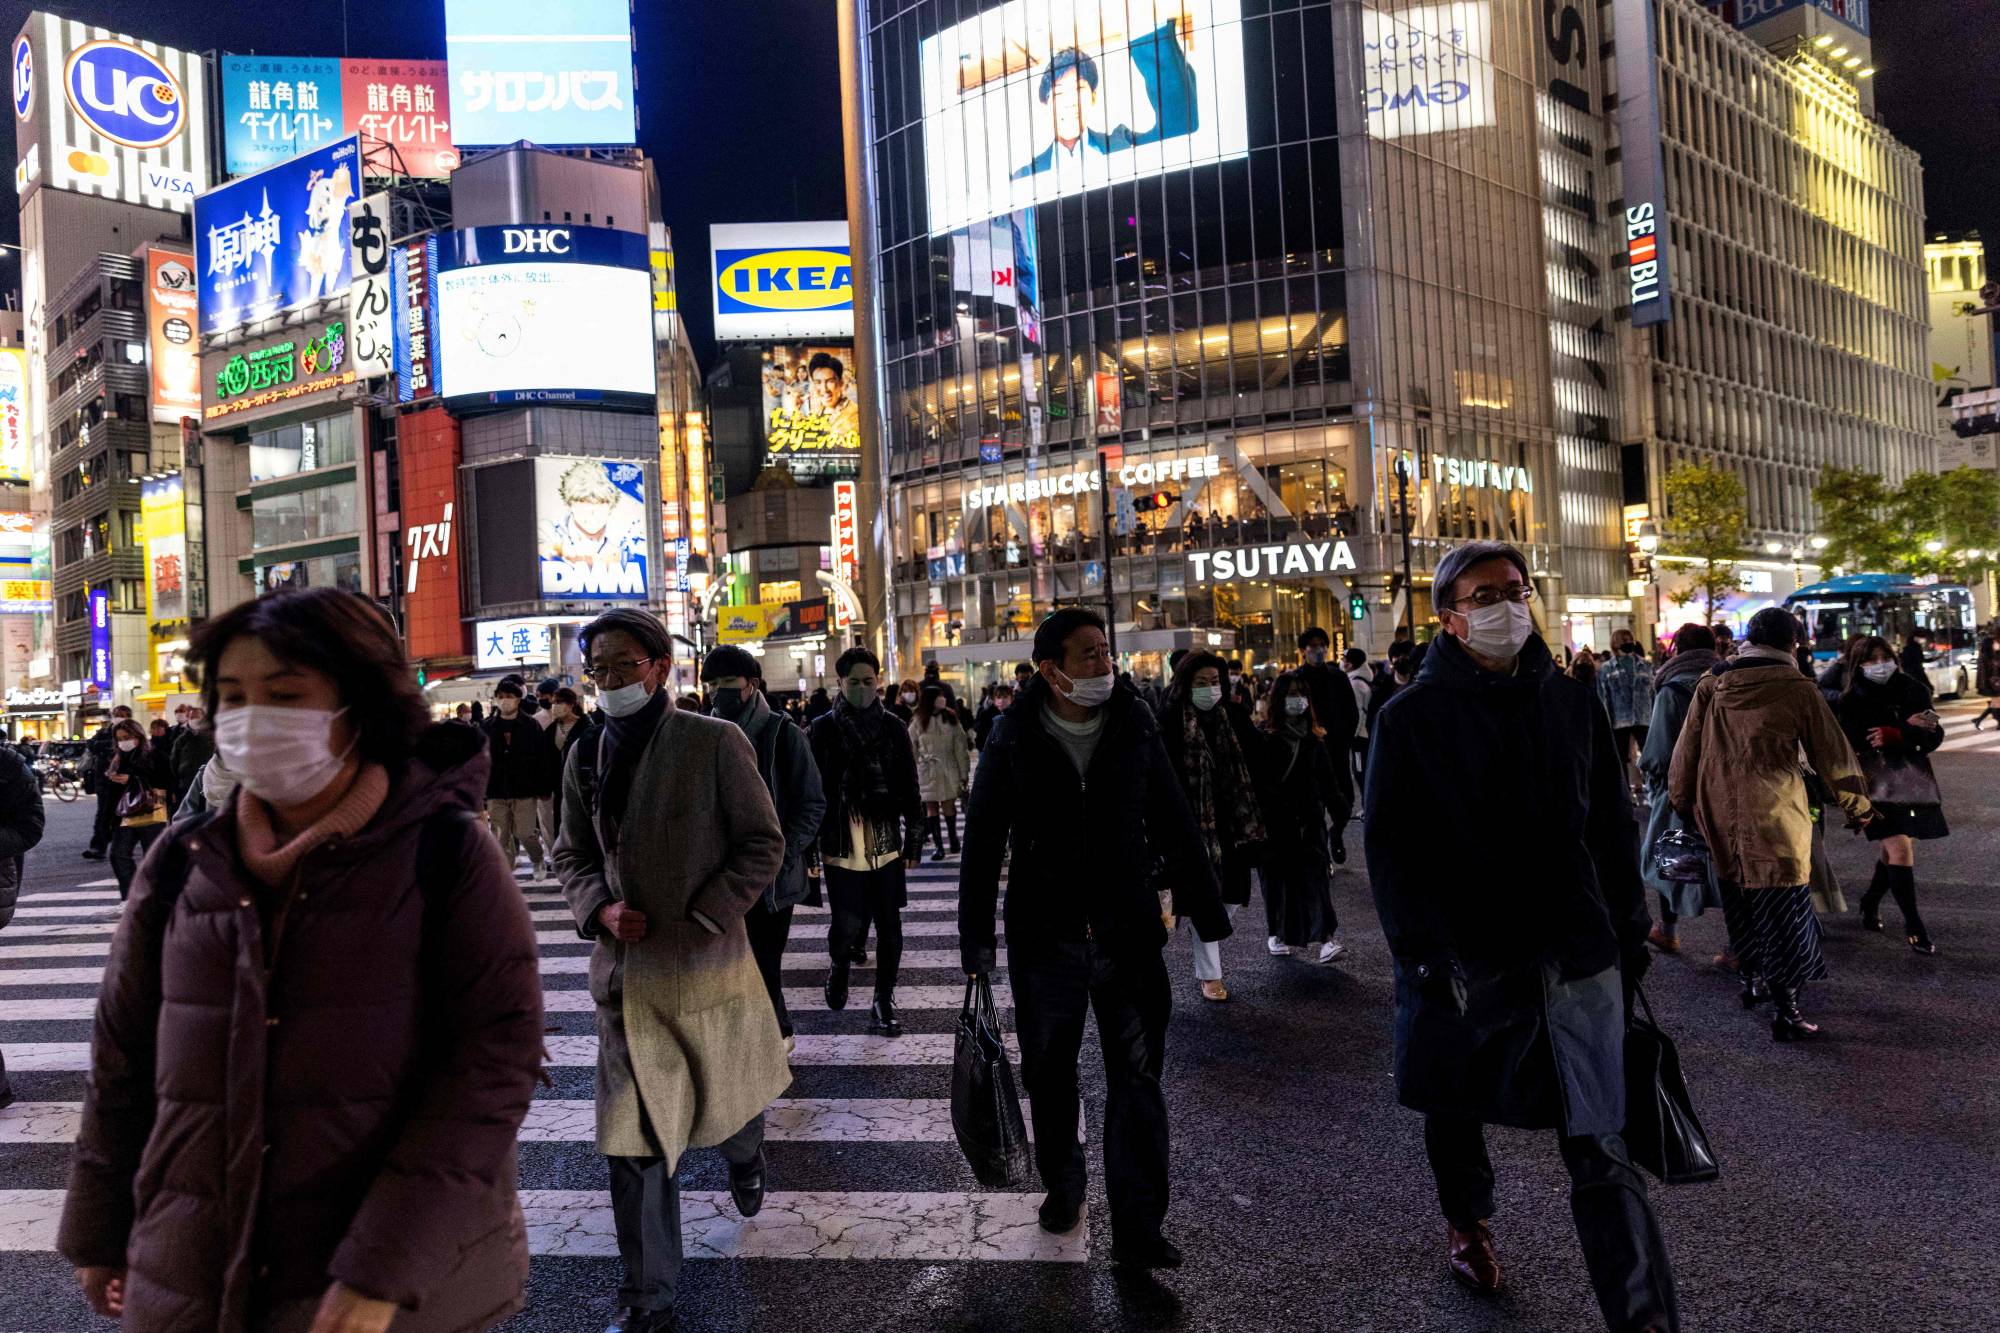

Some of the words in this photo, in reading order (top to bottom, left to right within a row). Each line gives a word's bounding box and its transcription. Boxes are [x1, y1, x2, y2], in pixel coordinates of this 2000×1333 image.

[79, 60, 175, 127] UC
[248, 80, 320, 110] 龍角散
[367, 83, 436, 113] 龍角散
[459, 70, 624, 113] サロンパス
[148, 172, 195, 195] VISA
[206, 187, 281, 288] 原神
[503, 229, 570, 254] DHC
[1626, 201, 1660, 305] SEIBU
[353, 203, 393, 370] もんじゃ
[734, 265, 851, 293] IKEA
[406, 248, 427, 390] 三千里薬品
[968, 470, 1100, 510] STARBUCKS
[1119, 454, 1220, 487] COFFEE
[1432, 453, 1532, 493] TSUTAYA
[541, 560, 647, 594] DMM
[1188, 541, 1357, 581] TSUTAYA
